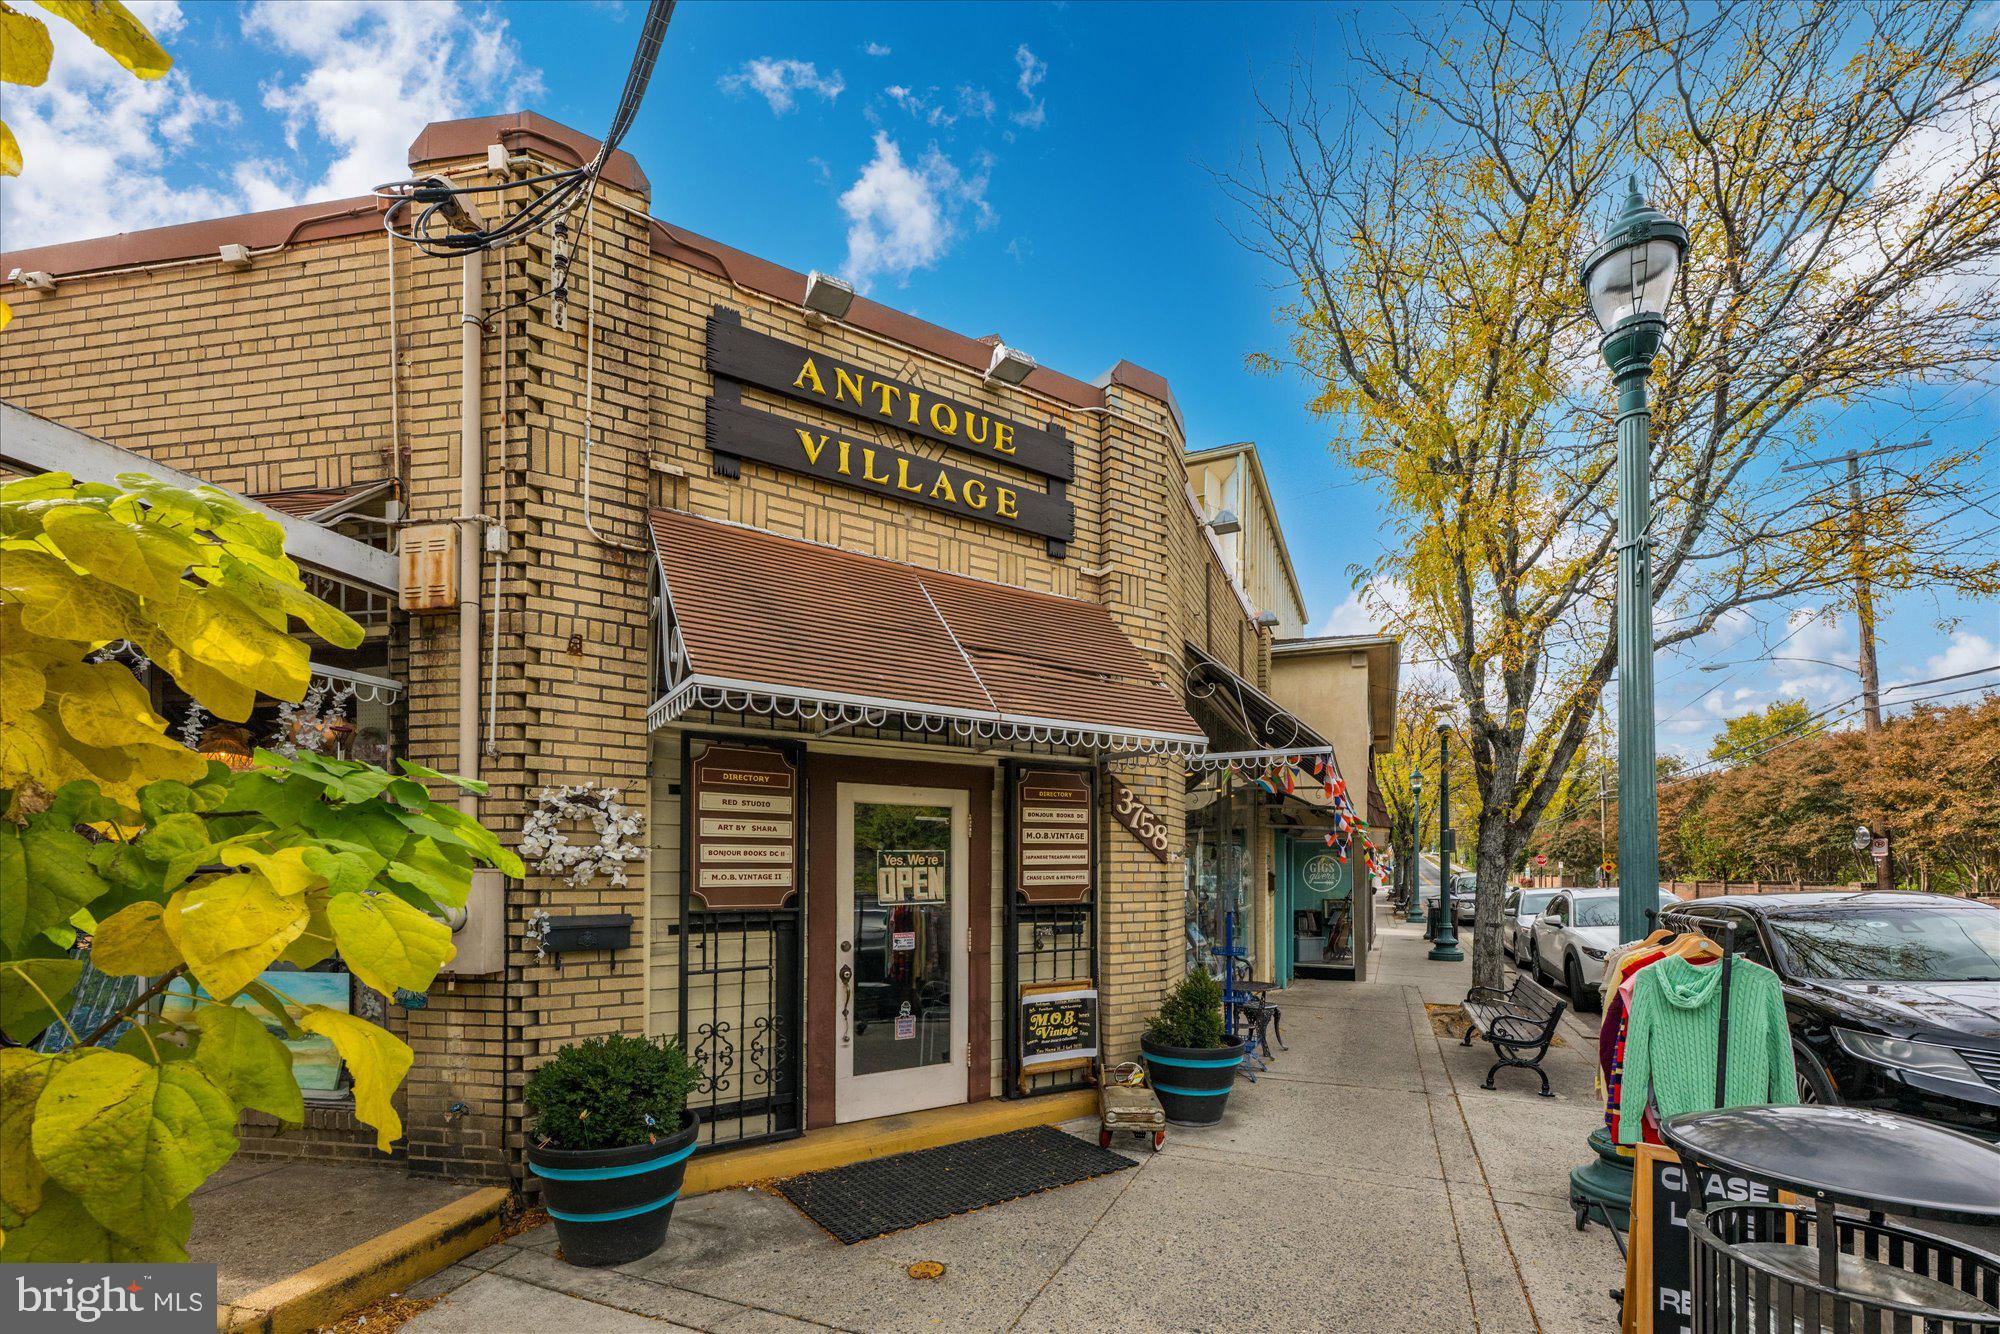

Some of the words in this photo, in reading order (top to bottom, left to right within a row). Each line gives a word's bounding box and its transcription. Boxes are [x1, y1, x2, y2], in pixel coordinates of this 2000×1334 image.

[792, 357, 1016, 456] ANTIQUE
[795, 428, 1019, 519] VILLAGE
[723, 773, 770, 783] DIRECTORY
[741, 800, 771, 808] STUDIO
[1116, 788, 1168, 851] 3758
[908, 854, 938, 865] We're
[738, 873, 772, 881] VINTAGE
[879, 866, 944, 902] OPEN
[1030, 1010, 1076, 1030] M.O.B.
[1036, 1026, 1078, 1039] Vintage
